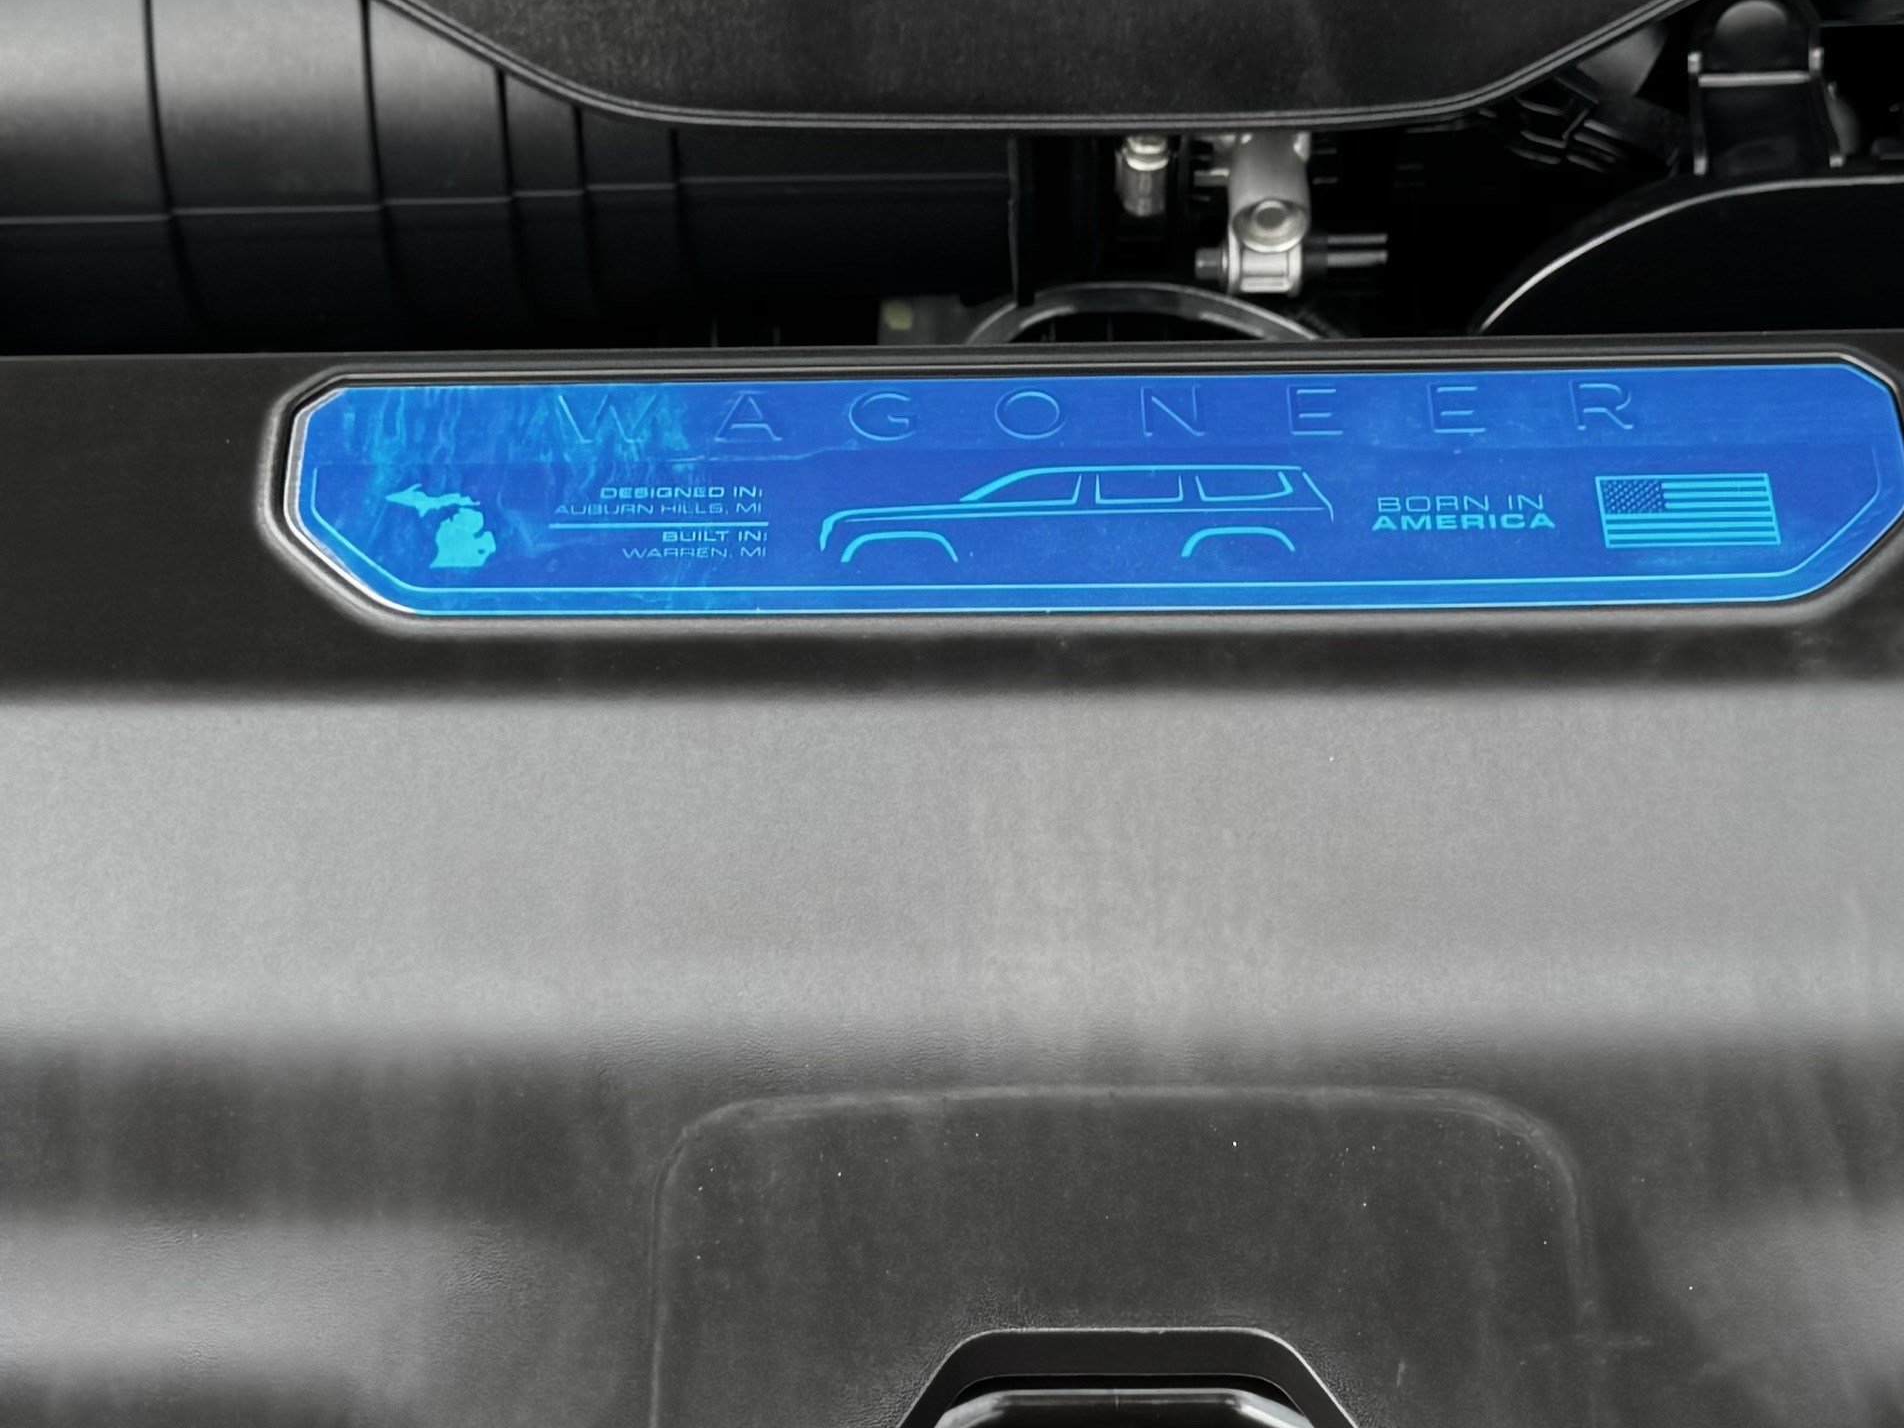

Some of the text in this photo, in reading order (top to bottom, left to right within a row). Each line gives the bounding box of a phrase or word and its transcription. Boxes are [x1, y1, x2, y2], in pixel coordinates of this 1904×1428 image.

[556, 379, 1633, 445] WAGONEER
[600, 486, 725, 499] DESIGNED
[554, 503, 654, 516] AUBURN
[736, 502, 762, 514] MI
[1377, 493, 1544, 513] BORN IN
[1371, 513, 1556, 531] AMERICA
[662, 530, 730, 543] BUILT
[740, 546, 767, 557] MI
